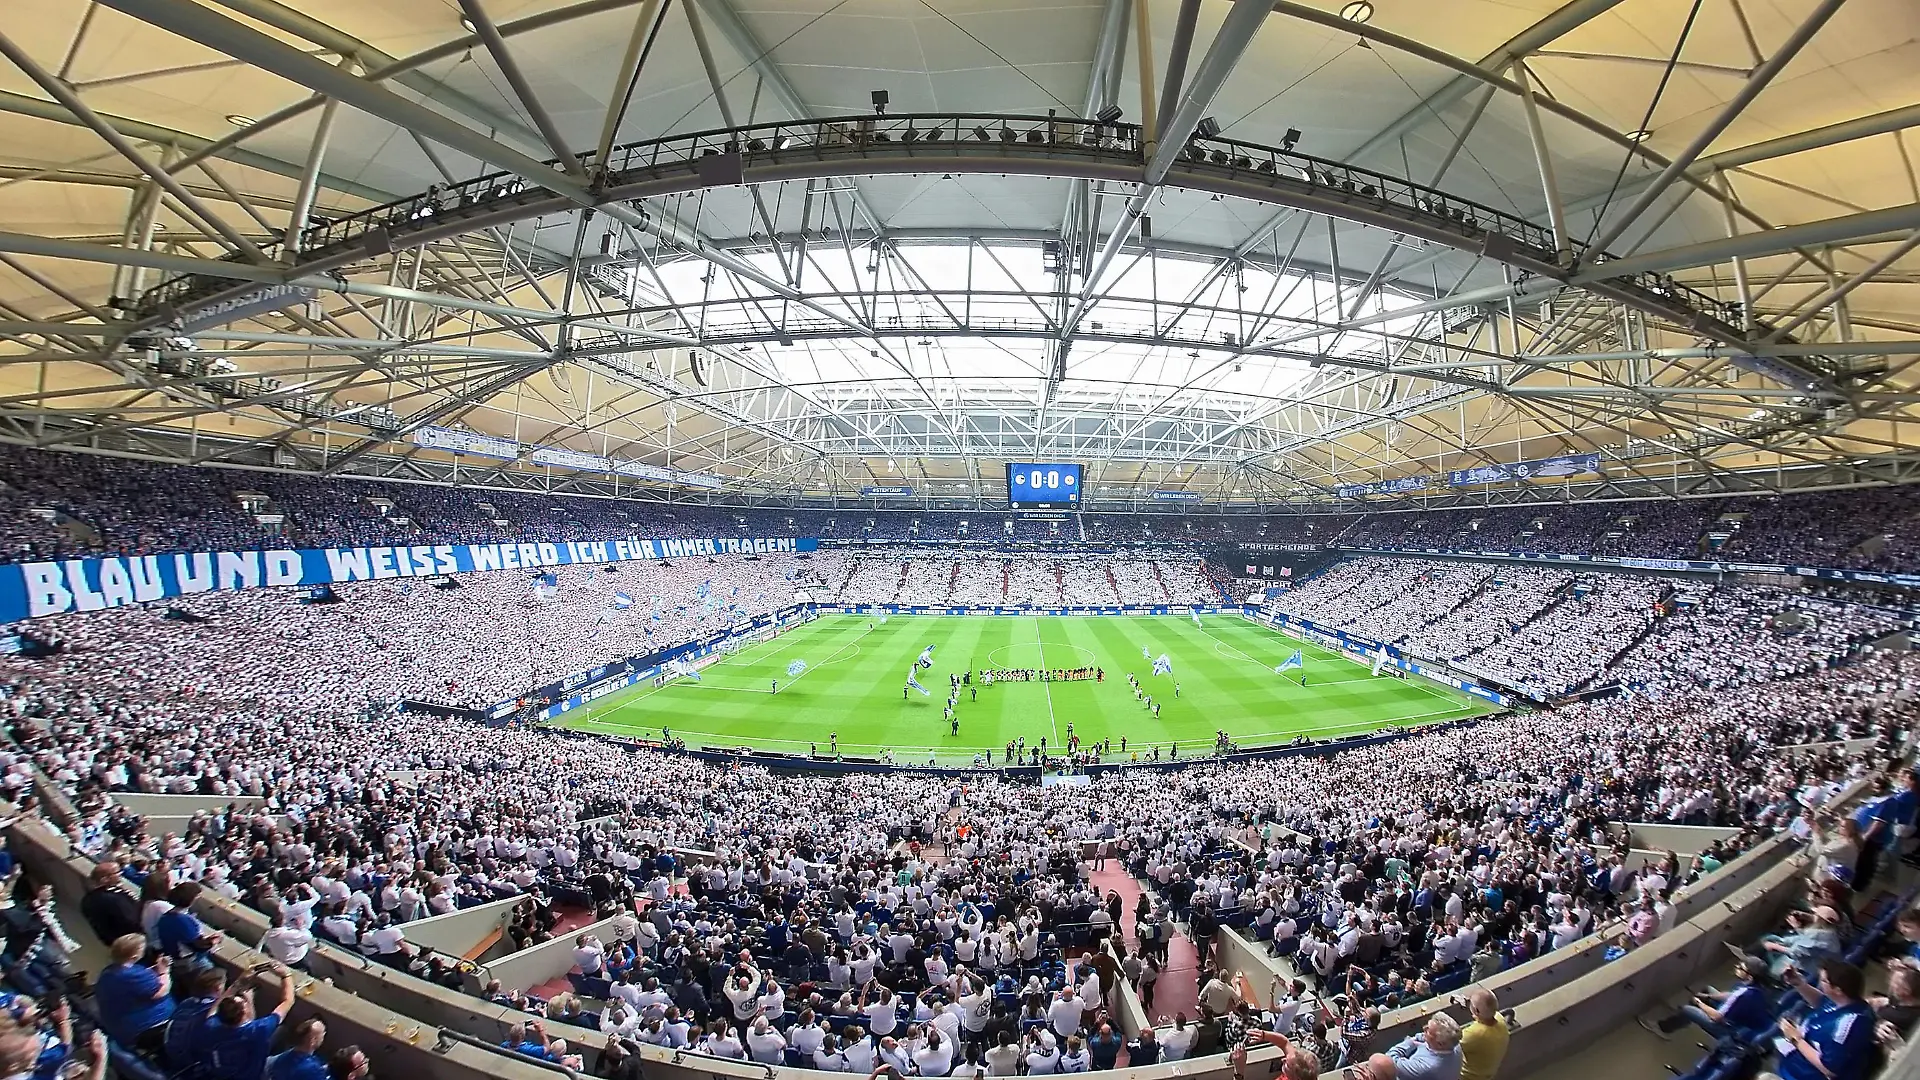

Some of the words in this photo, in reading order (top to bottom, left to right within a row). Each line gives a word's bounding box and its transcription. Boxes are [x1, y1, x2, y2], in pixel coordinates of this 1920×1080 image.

[1031, 470, 1059, 489] 0:0
[22, 555, 165, 617] BLAU
[174, 550, 304, 593] UND
[323, 546, 460, 583] WEISS
[468, 543, 559, 570] WERD
[566, 541, 606, 564] ICH
[615, 536, 656, 560] FÜR
[659, 538, 715, 557] IMMER
[718, 537, 798, 554] TRAGEN!
